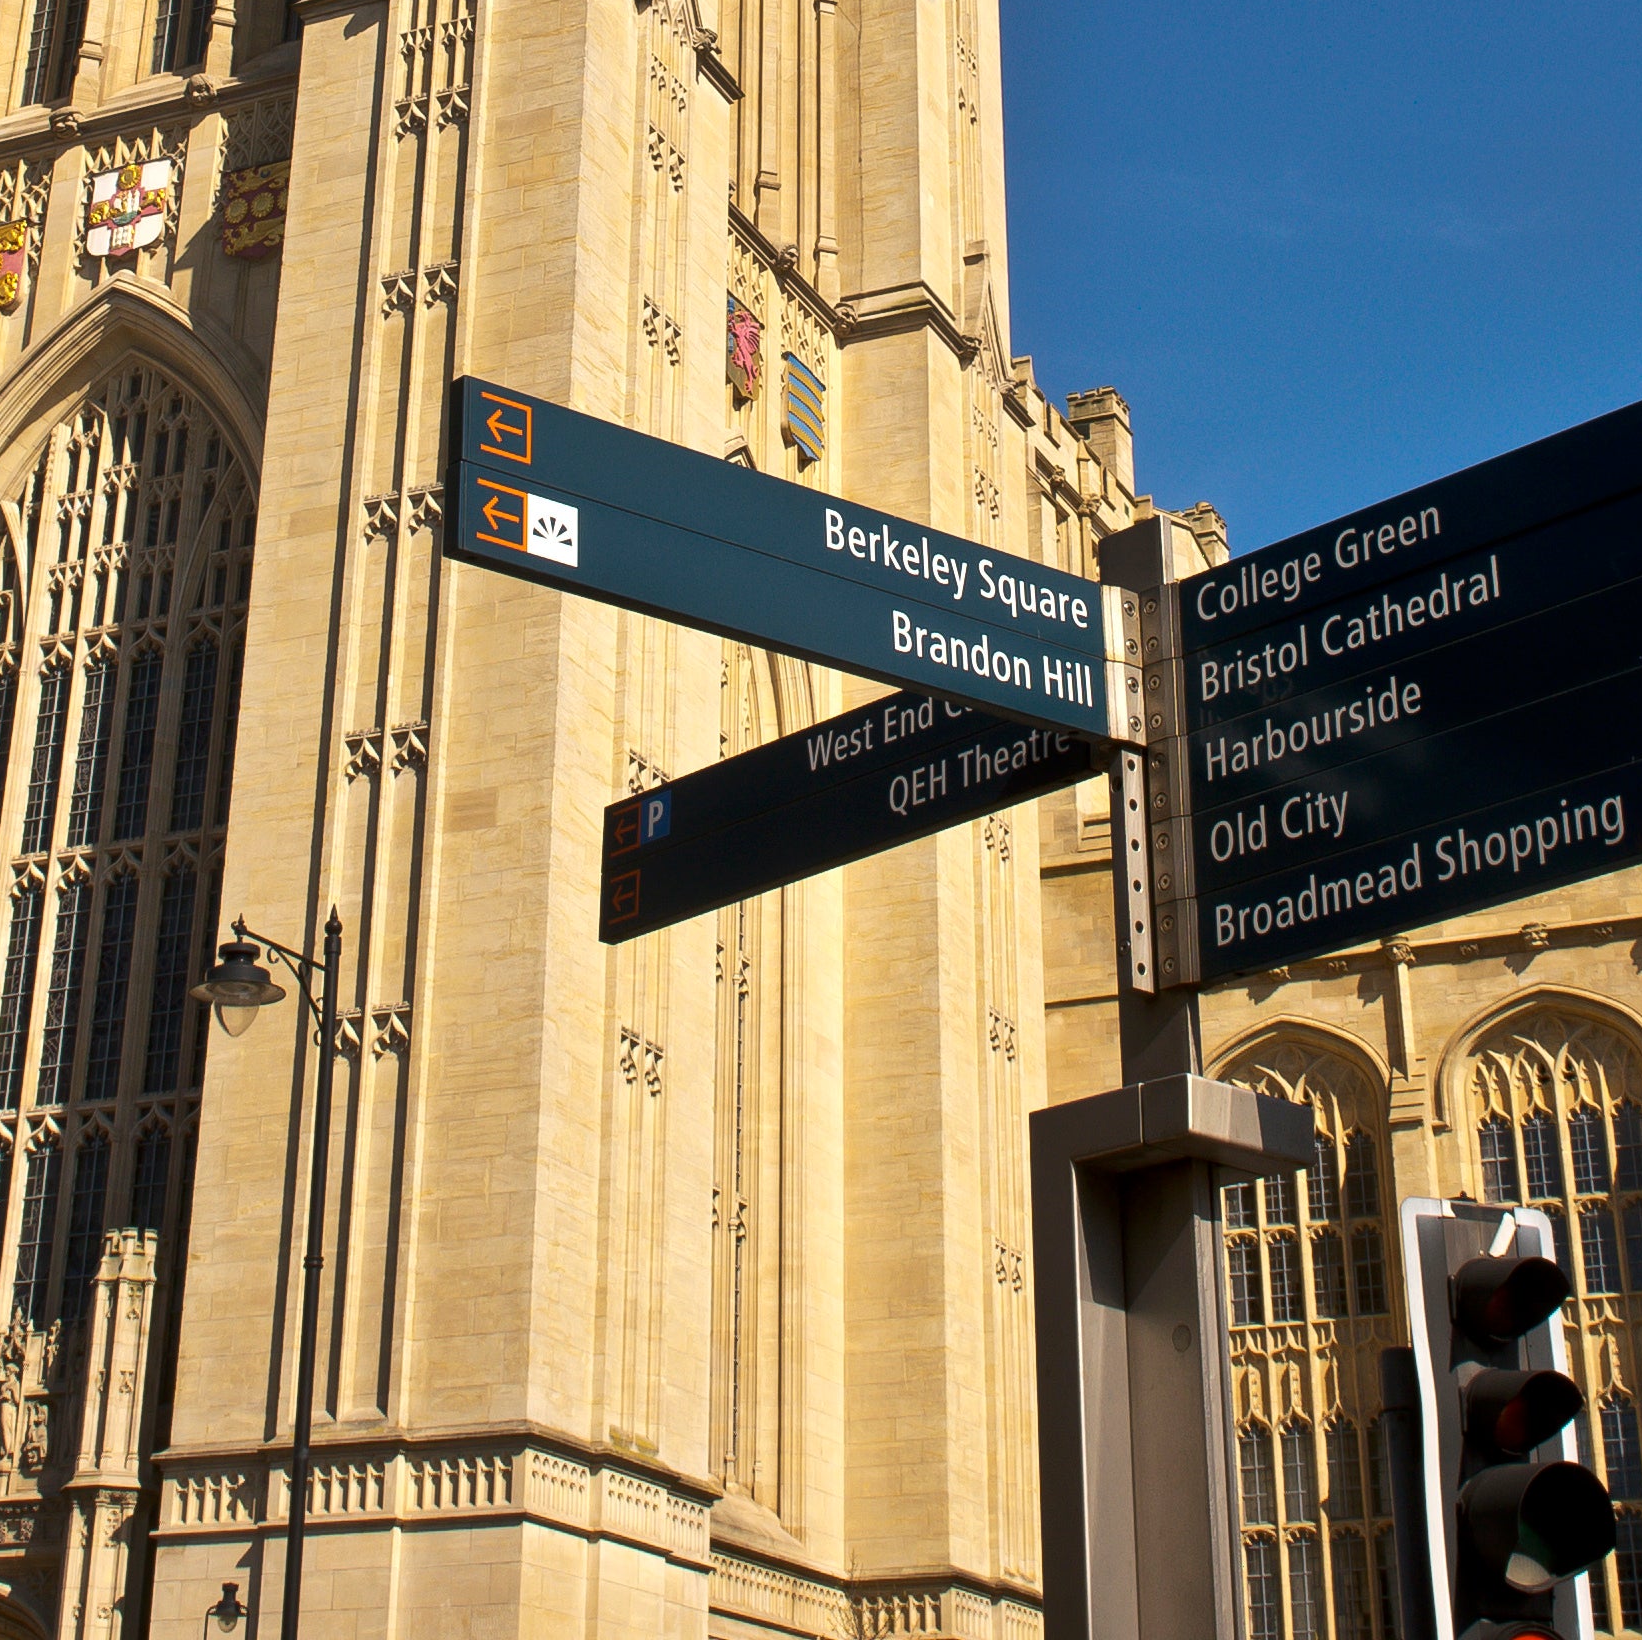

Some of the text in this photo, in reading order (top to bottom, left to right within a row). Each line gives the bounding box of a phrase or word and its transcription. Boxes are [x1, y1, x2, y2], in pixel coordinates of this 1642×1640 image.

[825, 507, 1088, 629] Berkeley Square
[1197, 506, 1440, 621] College Green
[892, 609, 1093, 708] Brandon Hill
[1201, 554, 1500, 702] Bristol Cathedral
[807, 696, 933, 772] West End
[889, 727, 1070, 816] QEH Theatre
[1205, 676, 1422, 782] Harbourside
[648, 800, 664, 838] P
[1210, 789, 1349, 862] Old City
[1215, 794, 1626, 946] Broadmead Shopping
